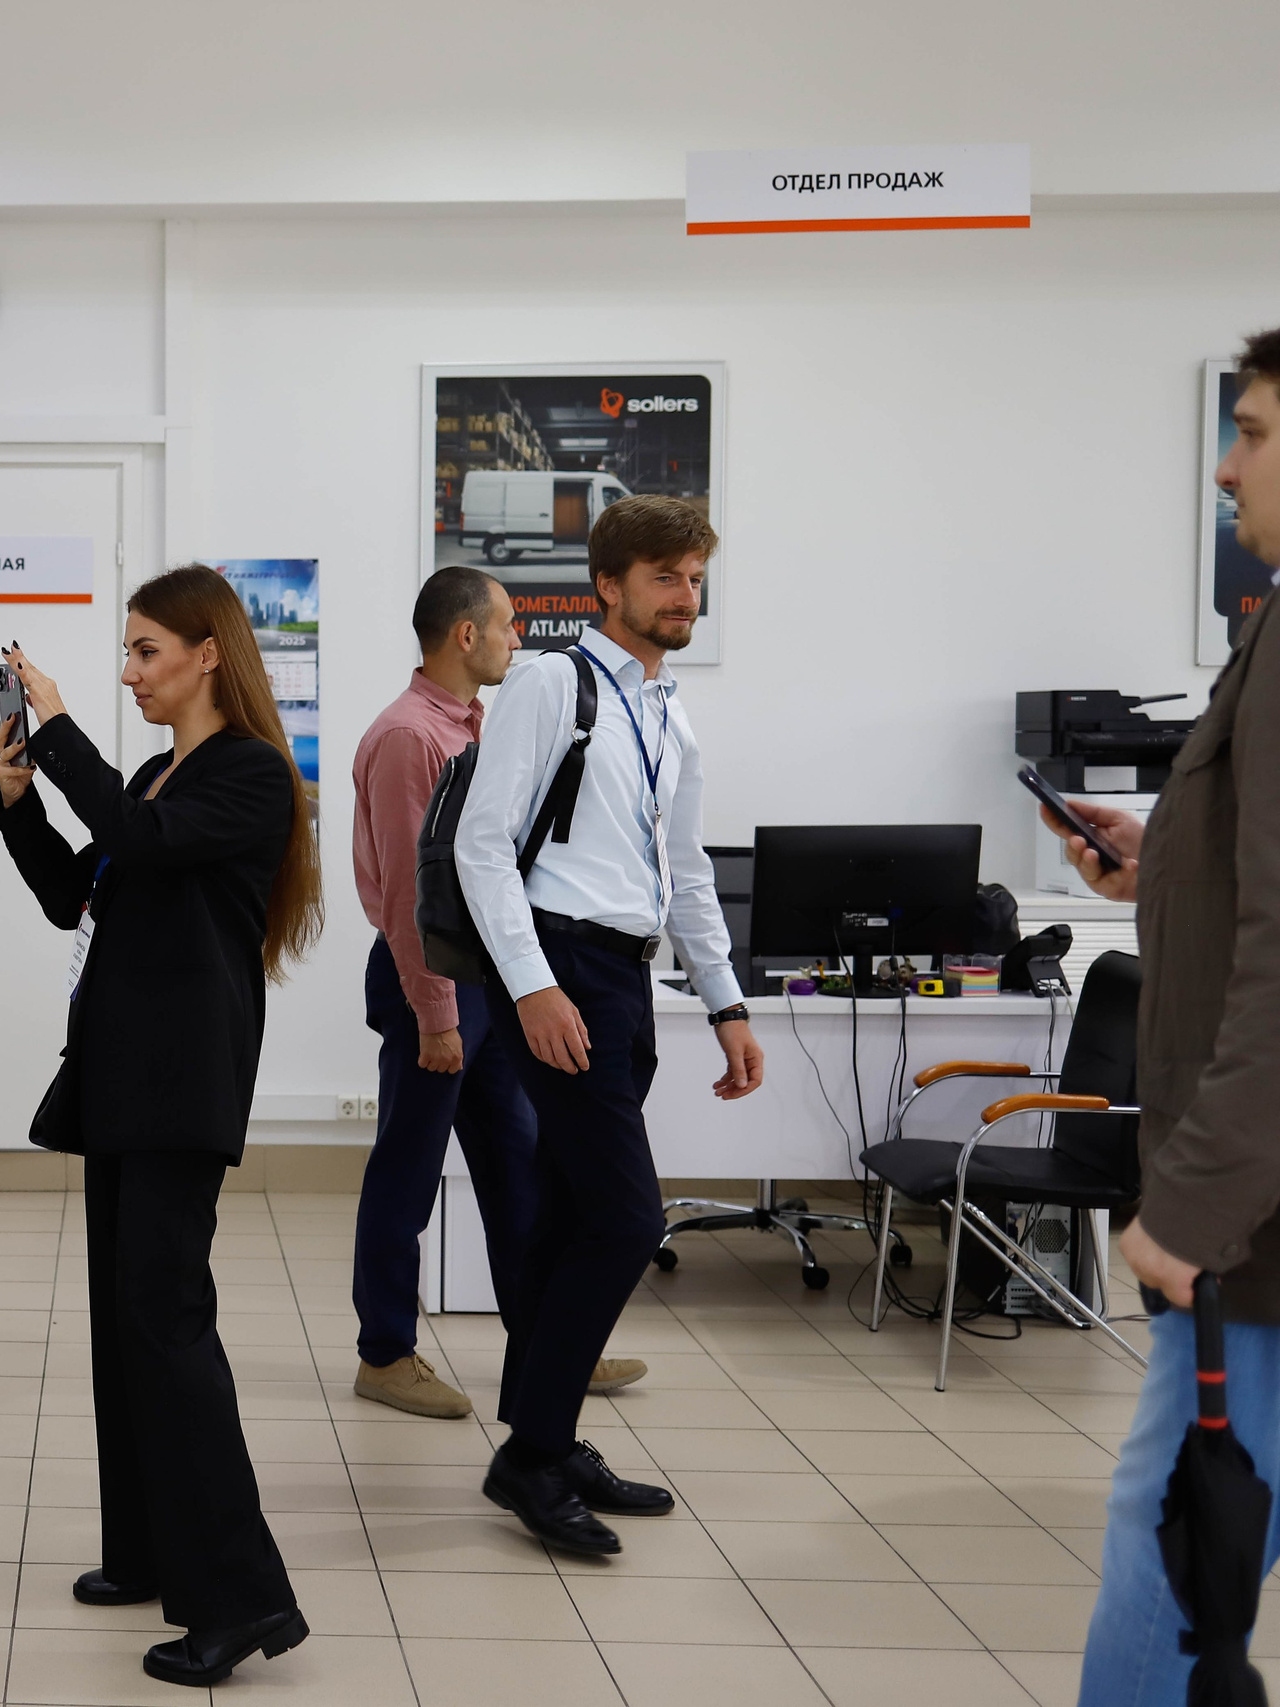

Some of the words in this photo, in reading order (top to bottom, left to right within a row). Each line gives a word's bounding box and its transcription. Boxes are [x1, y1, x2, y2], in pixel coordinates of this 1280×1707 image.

[772, 173, 841, 193] ОТДЕЛ
[847, 171, 944, 191] ПРОДАЖ
[627, 395, 698, 412] sollers
[511, 595, 600, 613] ОМЕТАЛЛИ
[528, 619, 591, 637] ATLANT
[279, 635, 306, 646] 2025
